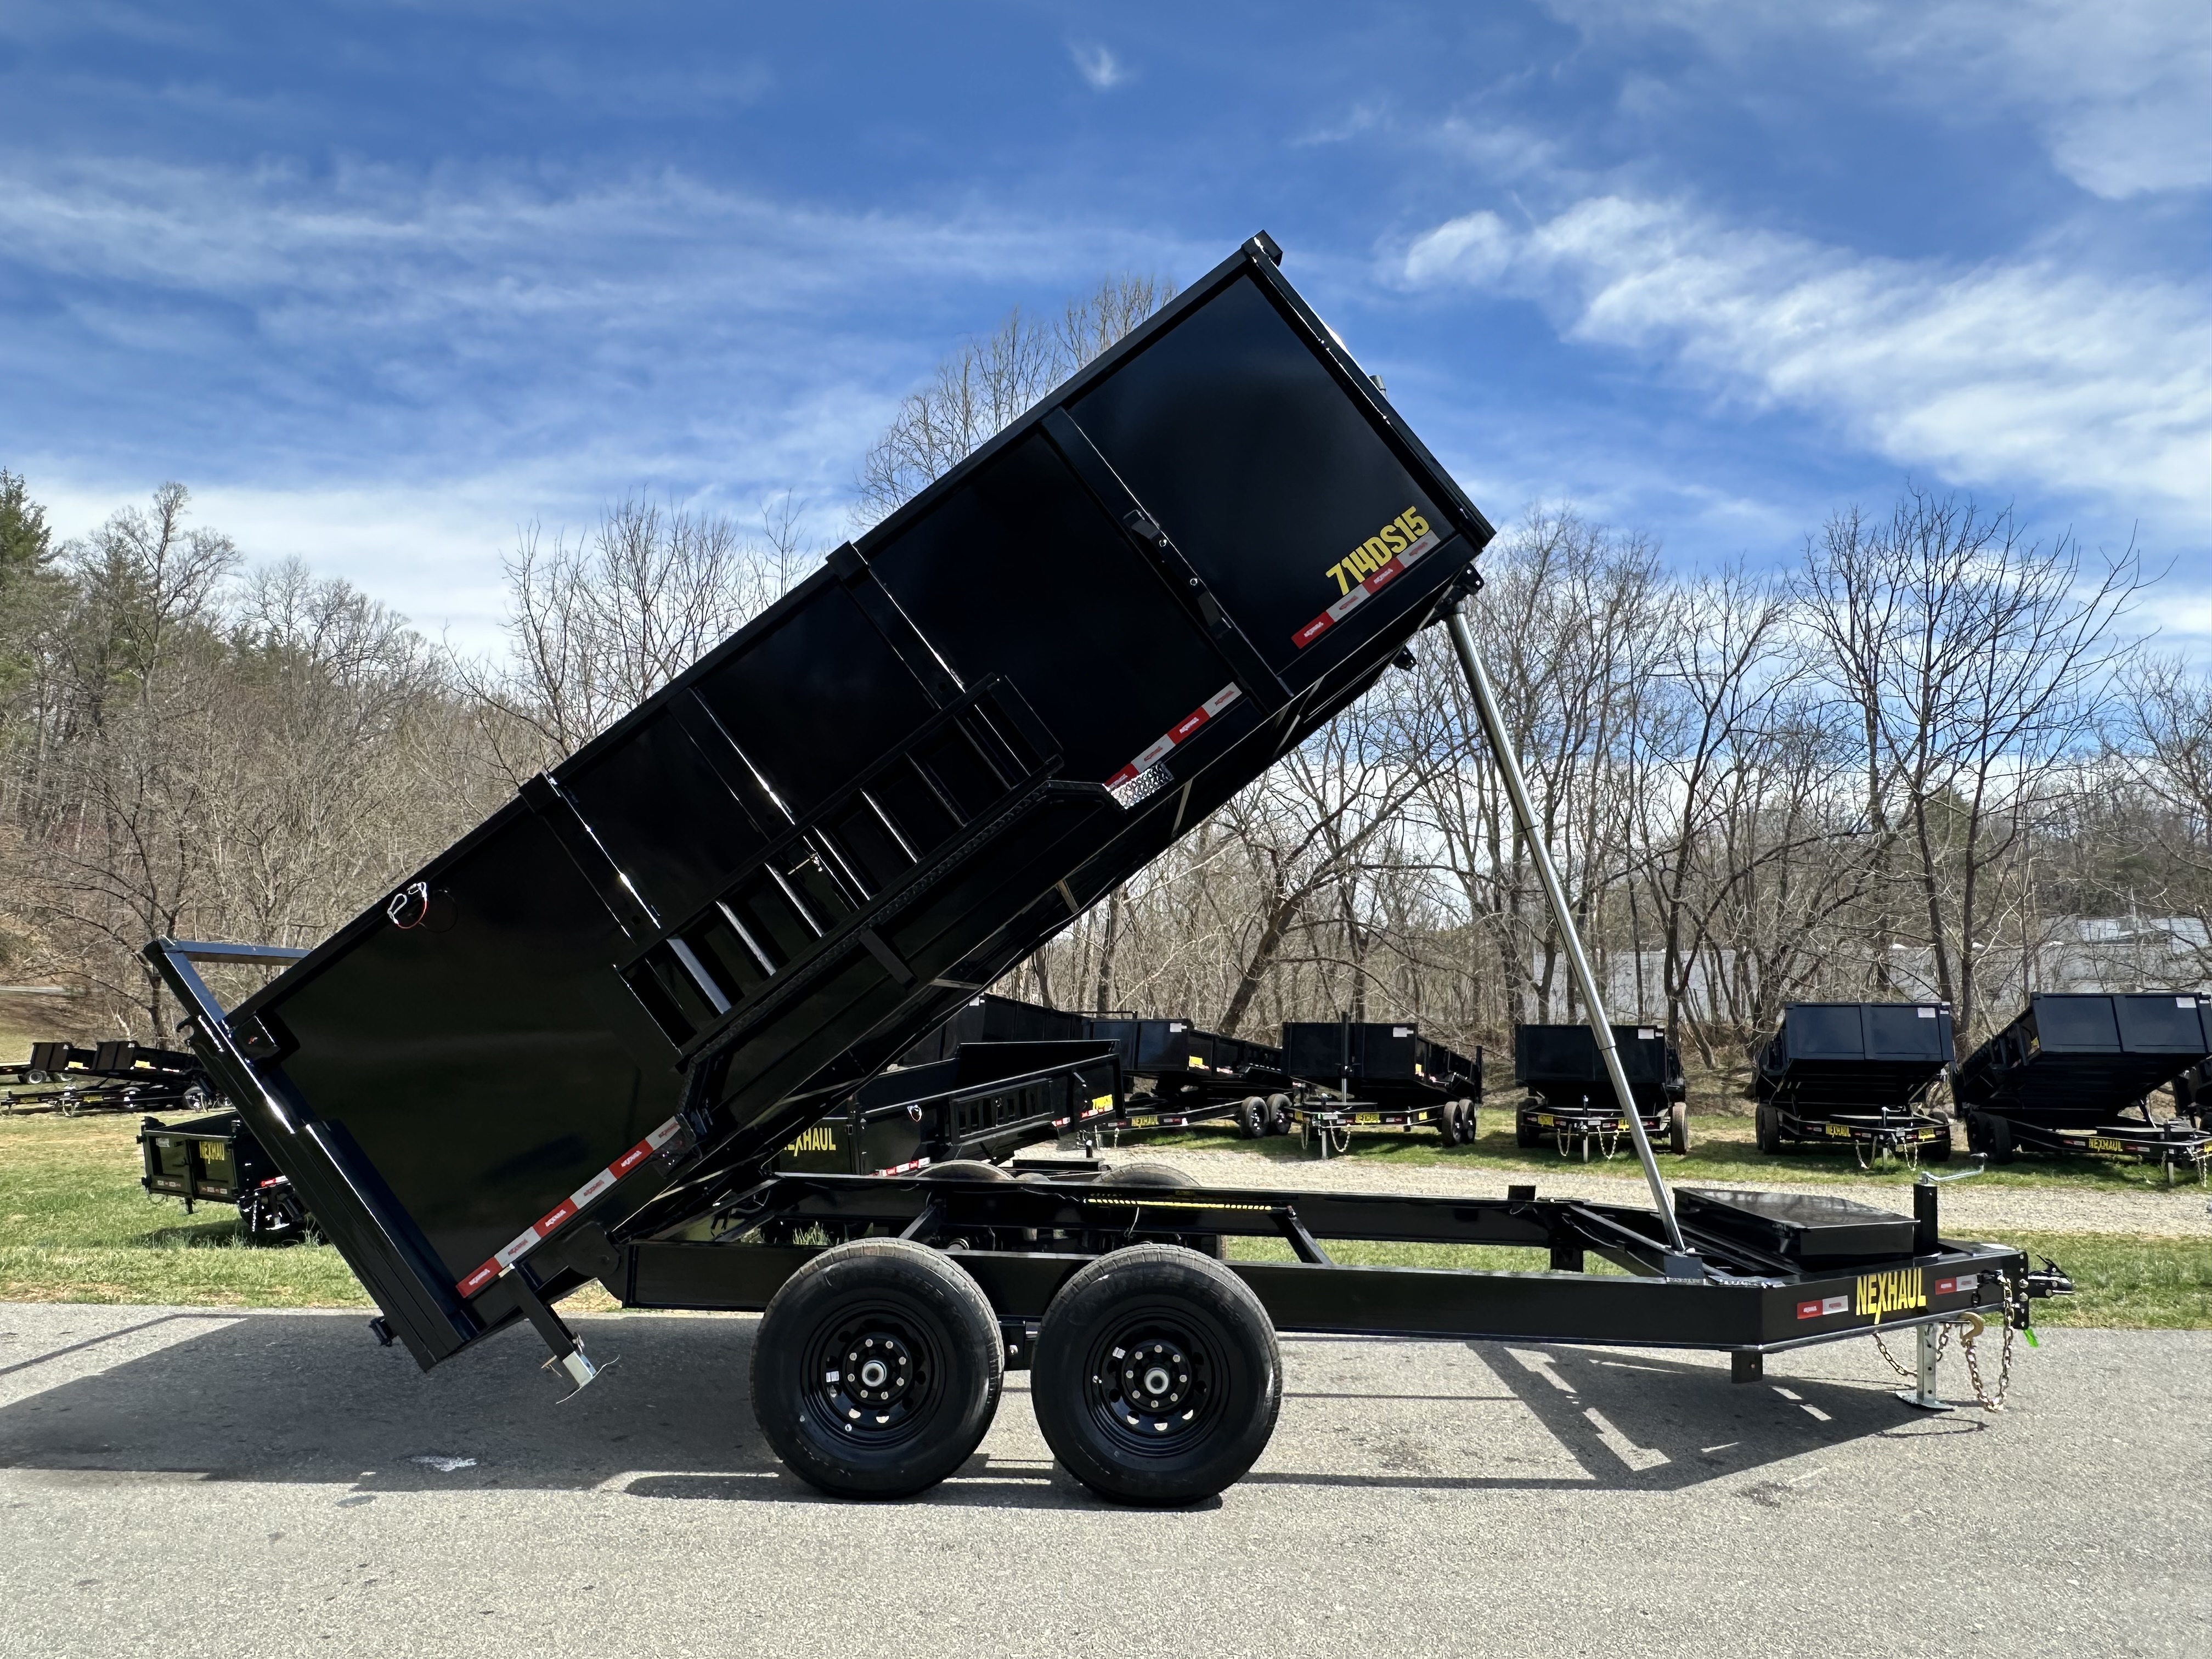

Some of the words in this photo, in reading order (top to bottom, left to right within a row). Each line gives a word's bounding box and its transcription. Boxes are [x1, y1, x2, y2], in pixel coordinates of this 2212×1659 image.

[1325, 506, 1430, 596] 714DS15
[783, 1127, 836, 1157] XHAUL
[1856, 1267, 1926, 1325] NEXHAUL
